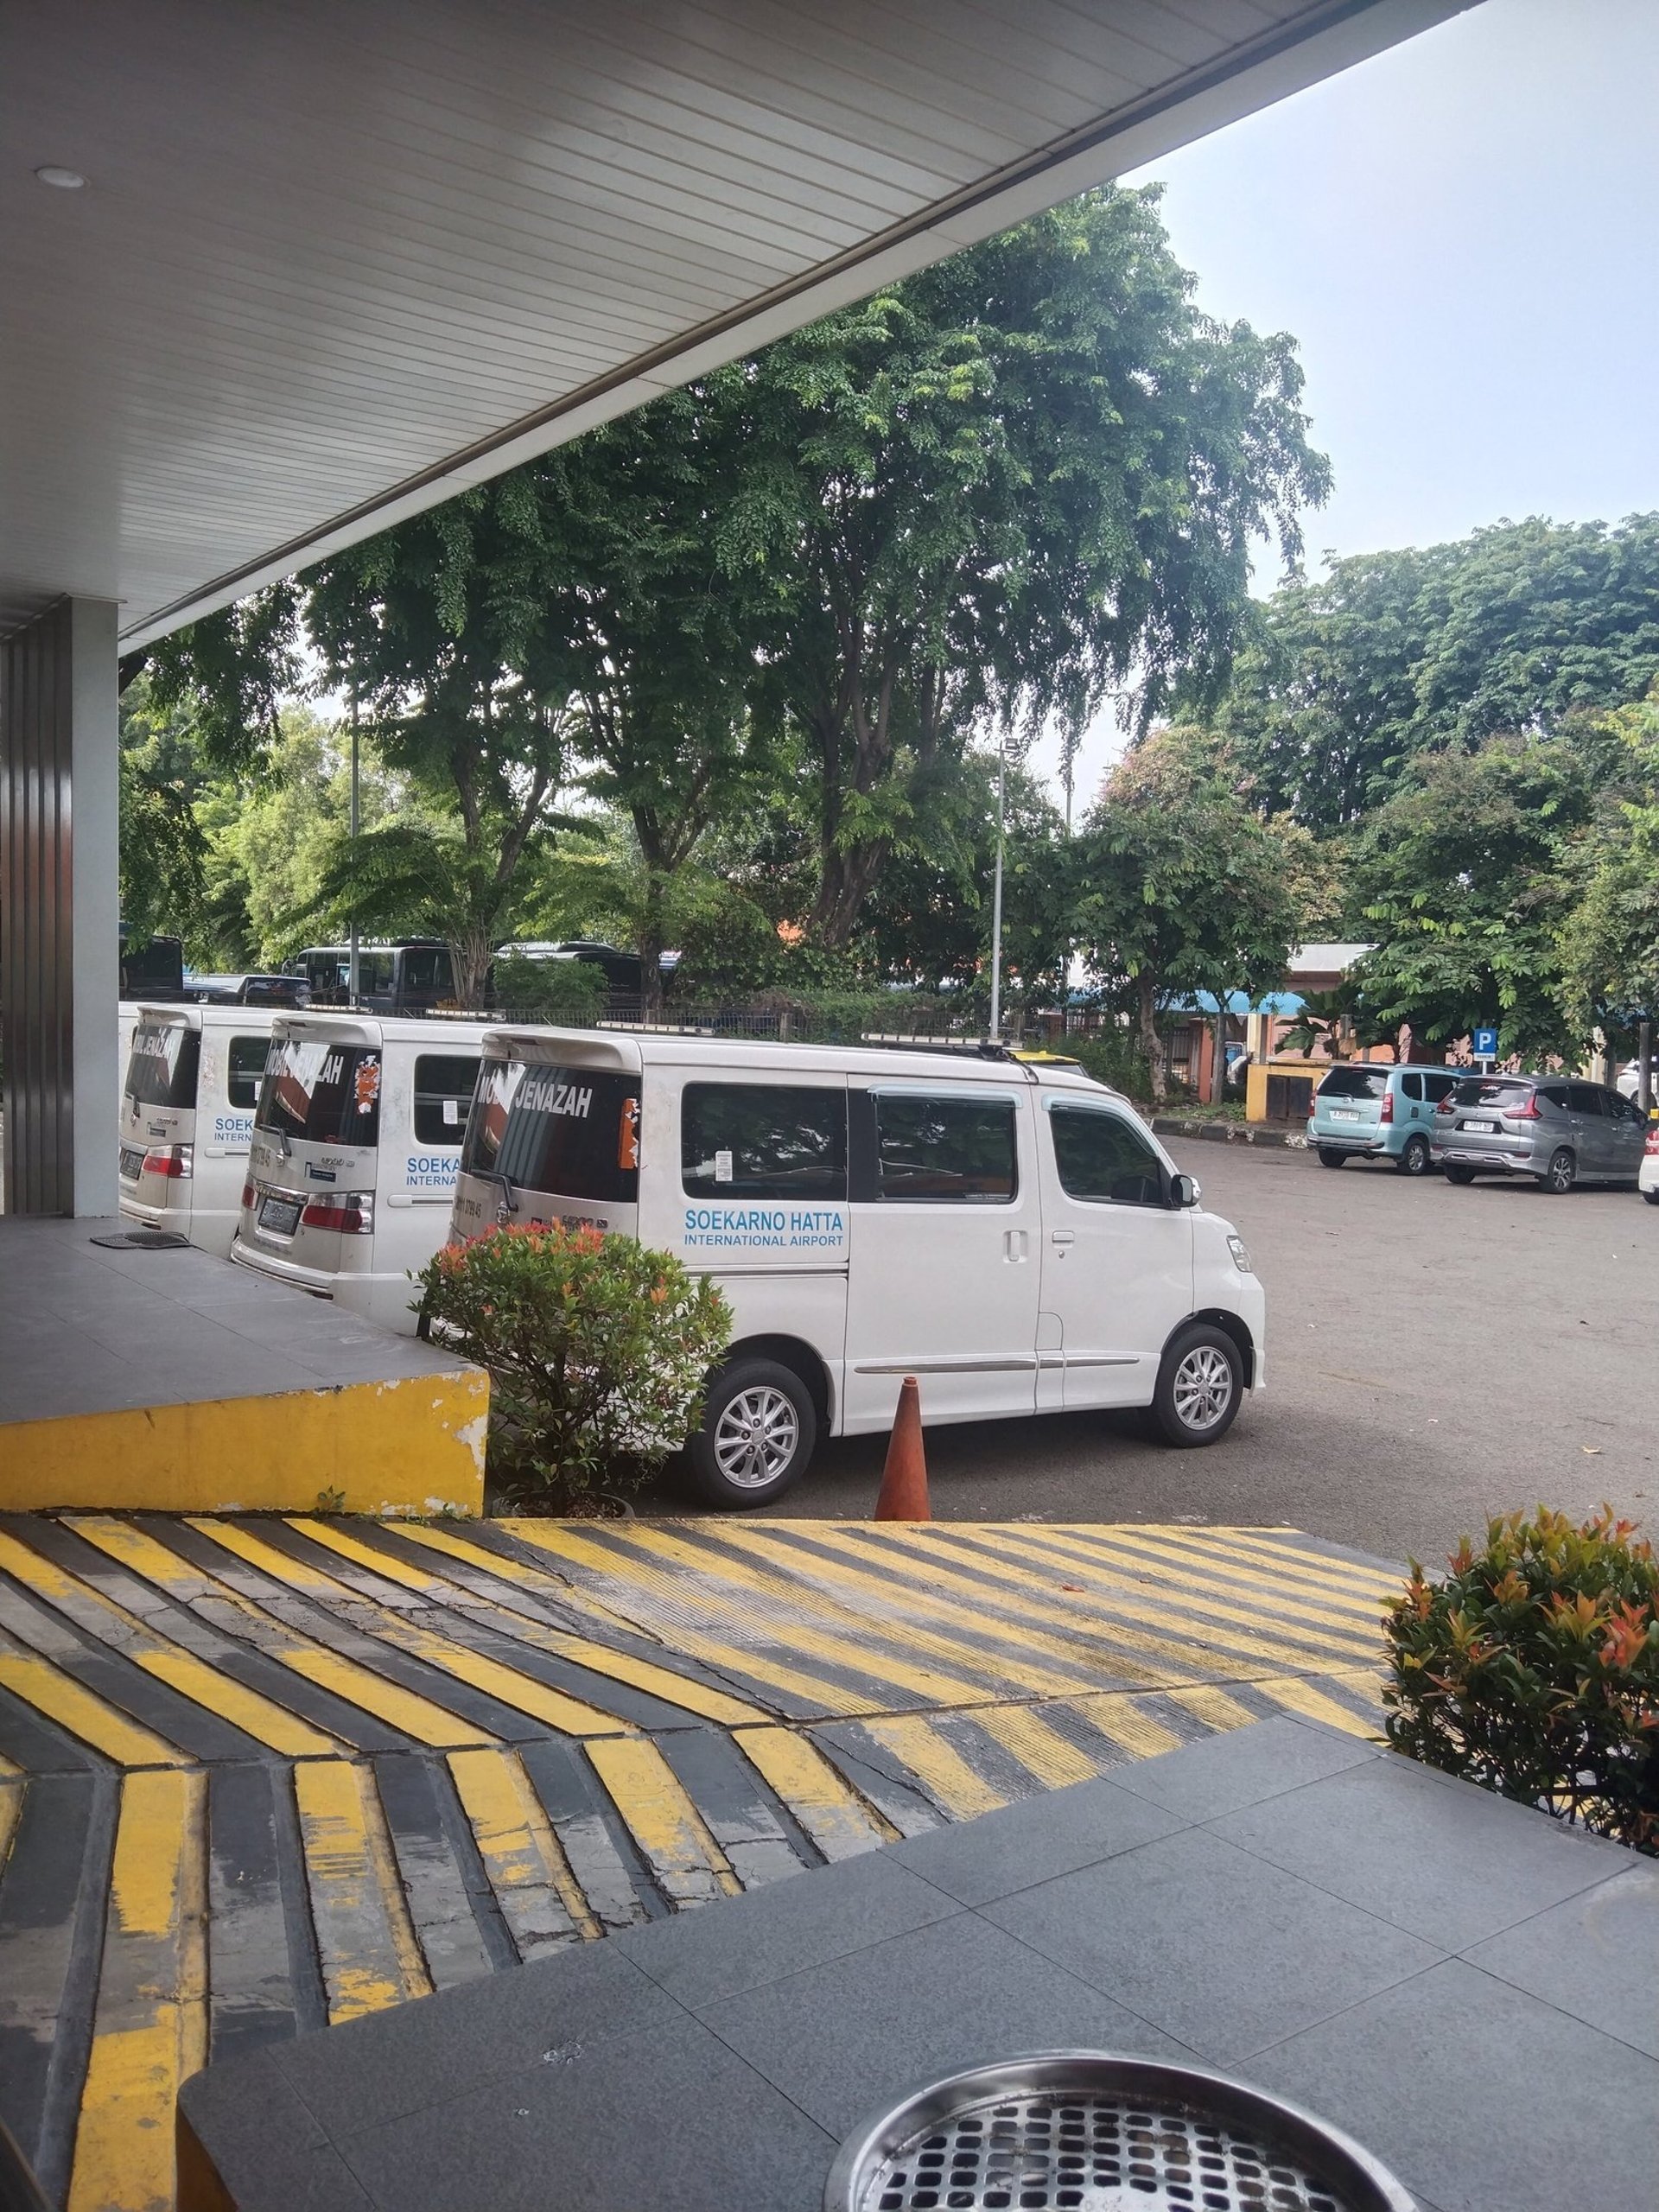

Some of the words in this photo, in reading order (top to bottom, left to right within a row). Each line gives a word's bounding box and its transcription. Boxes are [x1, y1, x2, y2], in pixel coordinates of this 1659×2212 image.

[1478, 1033, 1492, 1051] P
[516, 1079, 593, 1118] JENAZAH
[685, 1210, 785, 1230] SOEKARNO
[791, 1211, 843, 1231] HATTA
[684, 1234, 787, 1246] INTERNATIONAL
[789, 1235, 843, 1246] AIRPORT
